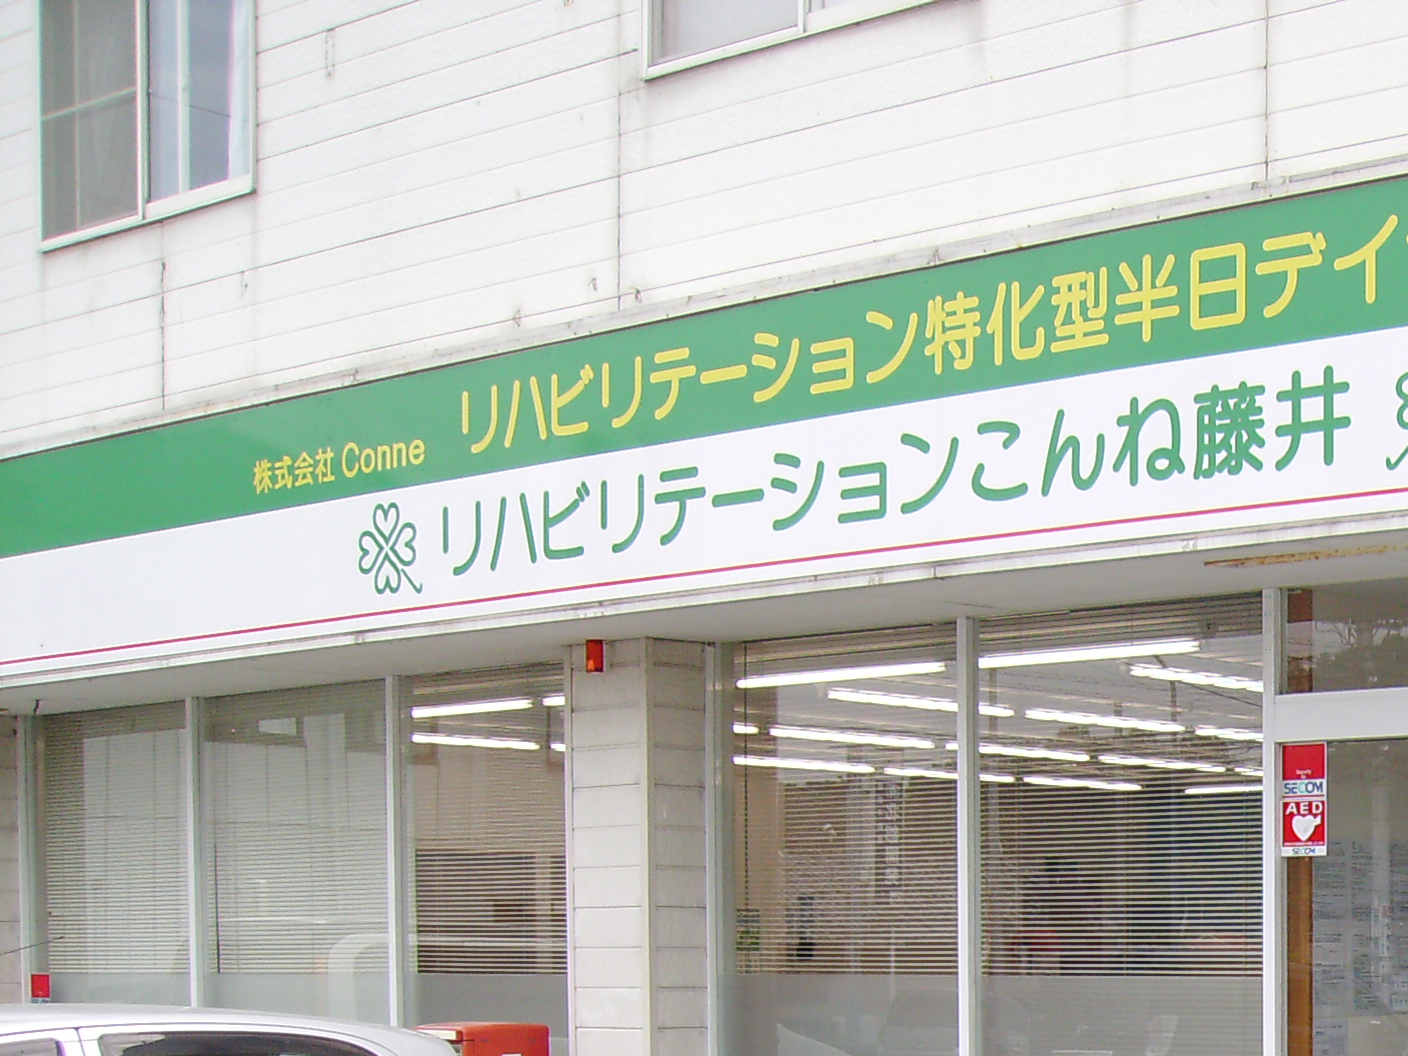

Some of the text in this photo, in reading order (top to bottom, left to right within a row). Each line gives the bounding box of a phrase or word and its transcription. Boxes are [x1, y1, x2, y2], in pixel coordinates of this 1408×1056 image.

[253, 447, 335, 493] 株式会社
[341, 439, 425, 477] Conne
[442, 364, 1352, 576] リハビリテーションこんね藤井
[1284, 782, 1324, 795] SECOM
[1285, 802, 1323, 815] AED
